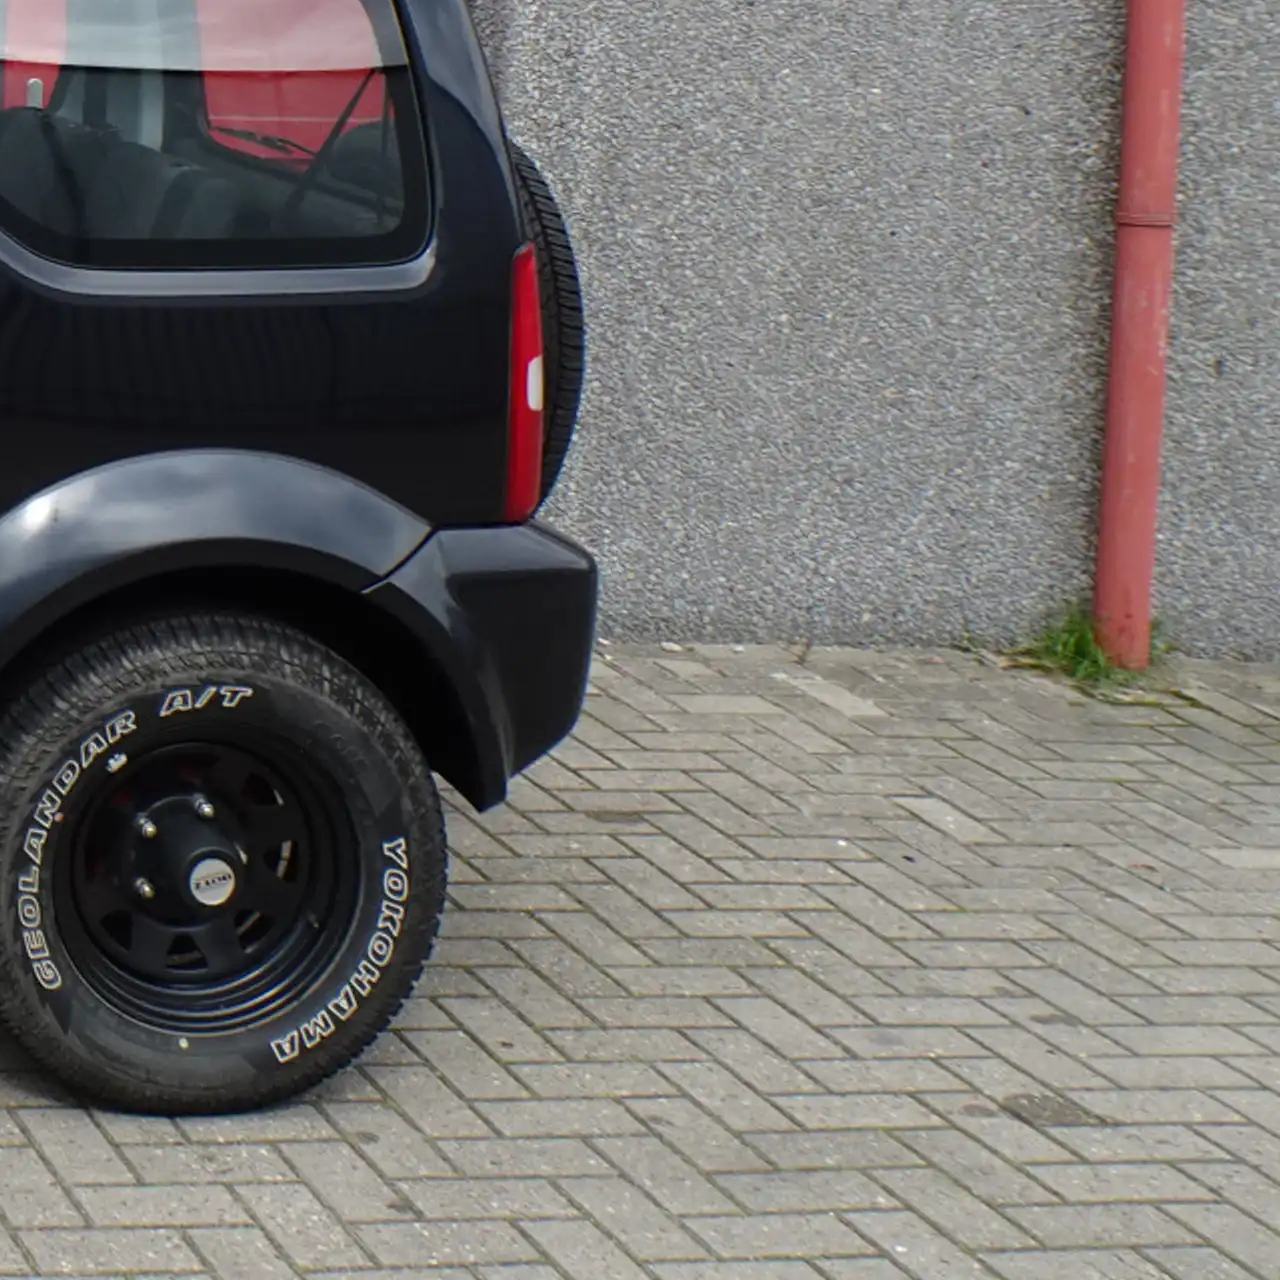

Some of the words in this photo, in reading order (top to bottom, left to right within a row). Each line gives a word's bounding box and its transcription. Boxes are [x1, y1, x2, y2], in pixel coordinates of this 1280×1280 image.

[17, 710, 138, 991] GEOLANDAR
[159, 684, 253, 718] A/T
[269, 837, 409, 1064] YOKOHAMA
